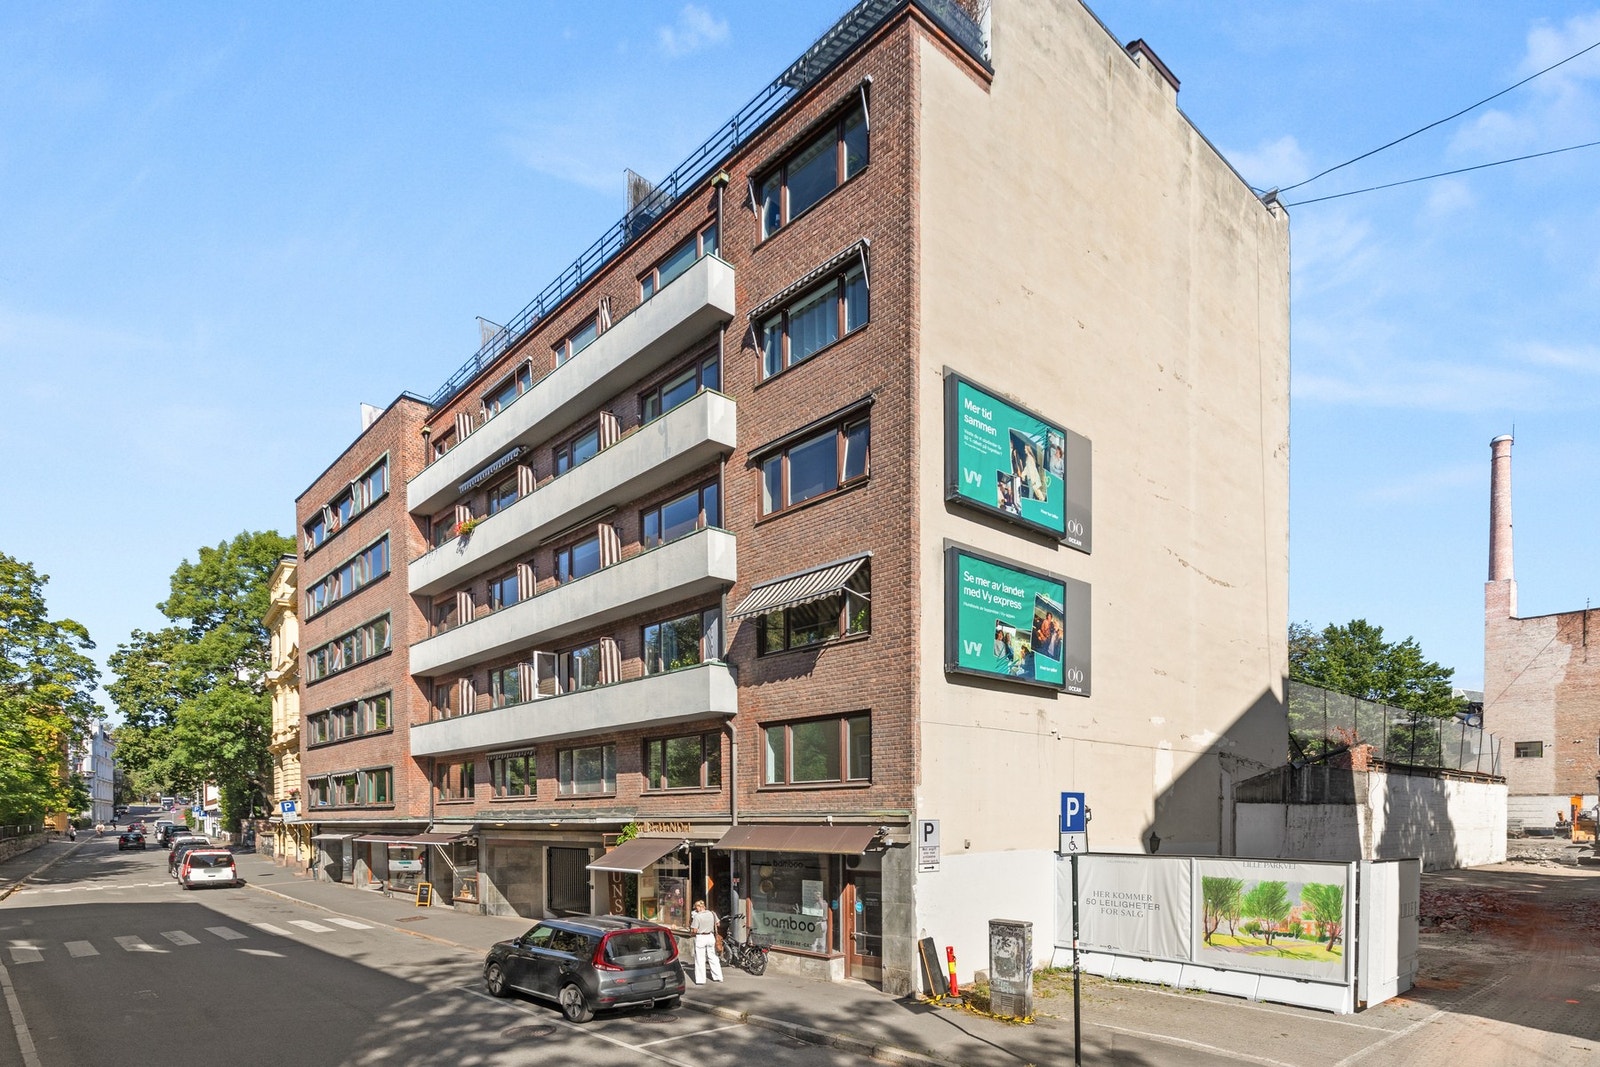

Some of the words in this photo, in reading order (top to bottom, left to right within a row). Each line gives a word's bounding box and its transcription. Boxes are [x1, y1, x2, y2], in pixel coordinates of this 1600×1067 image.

[964, 398, 980, 414] Mer
[982, 408, 992, 421] tid
[964, 414, 997, 437] sammen
[963, 571, 974, 583] Se
[975, 576, 990, 587] mer
[991, 581, 1001, 591] av
[1002, 583, 1025, 598] landet
[963, 587, 981, 599] med
[982, 590, 993, 604] Vy
[993, 595, 1022, 610] express
[284, 803, 292, 811] P
[1066, 797, 1080, 827] P
[924, 823, 934, 842] P
[773, 860, 804, 868] bamboo
[612, 871, 623, 915] UNS
[1093, 890, 1110, 899] HER
[1112, 892, 1153, 901] KOMMER
[1099, 900, 1161, 911] LEILIGHETER
[1100, 908, 1118, 916] FOR
[1121, 909, 1144, 918] SALG
[763, 913, 815, 932] bamboo
